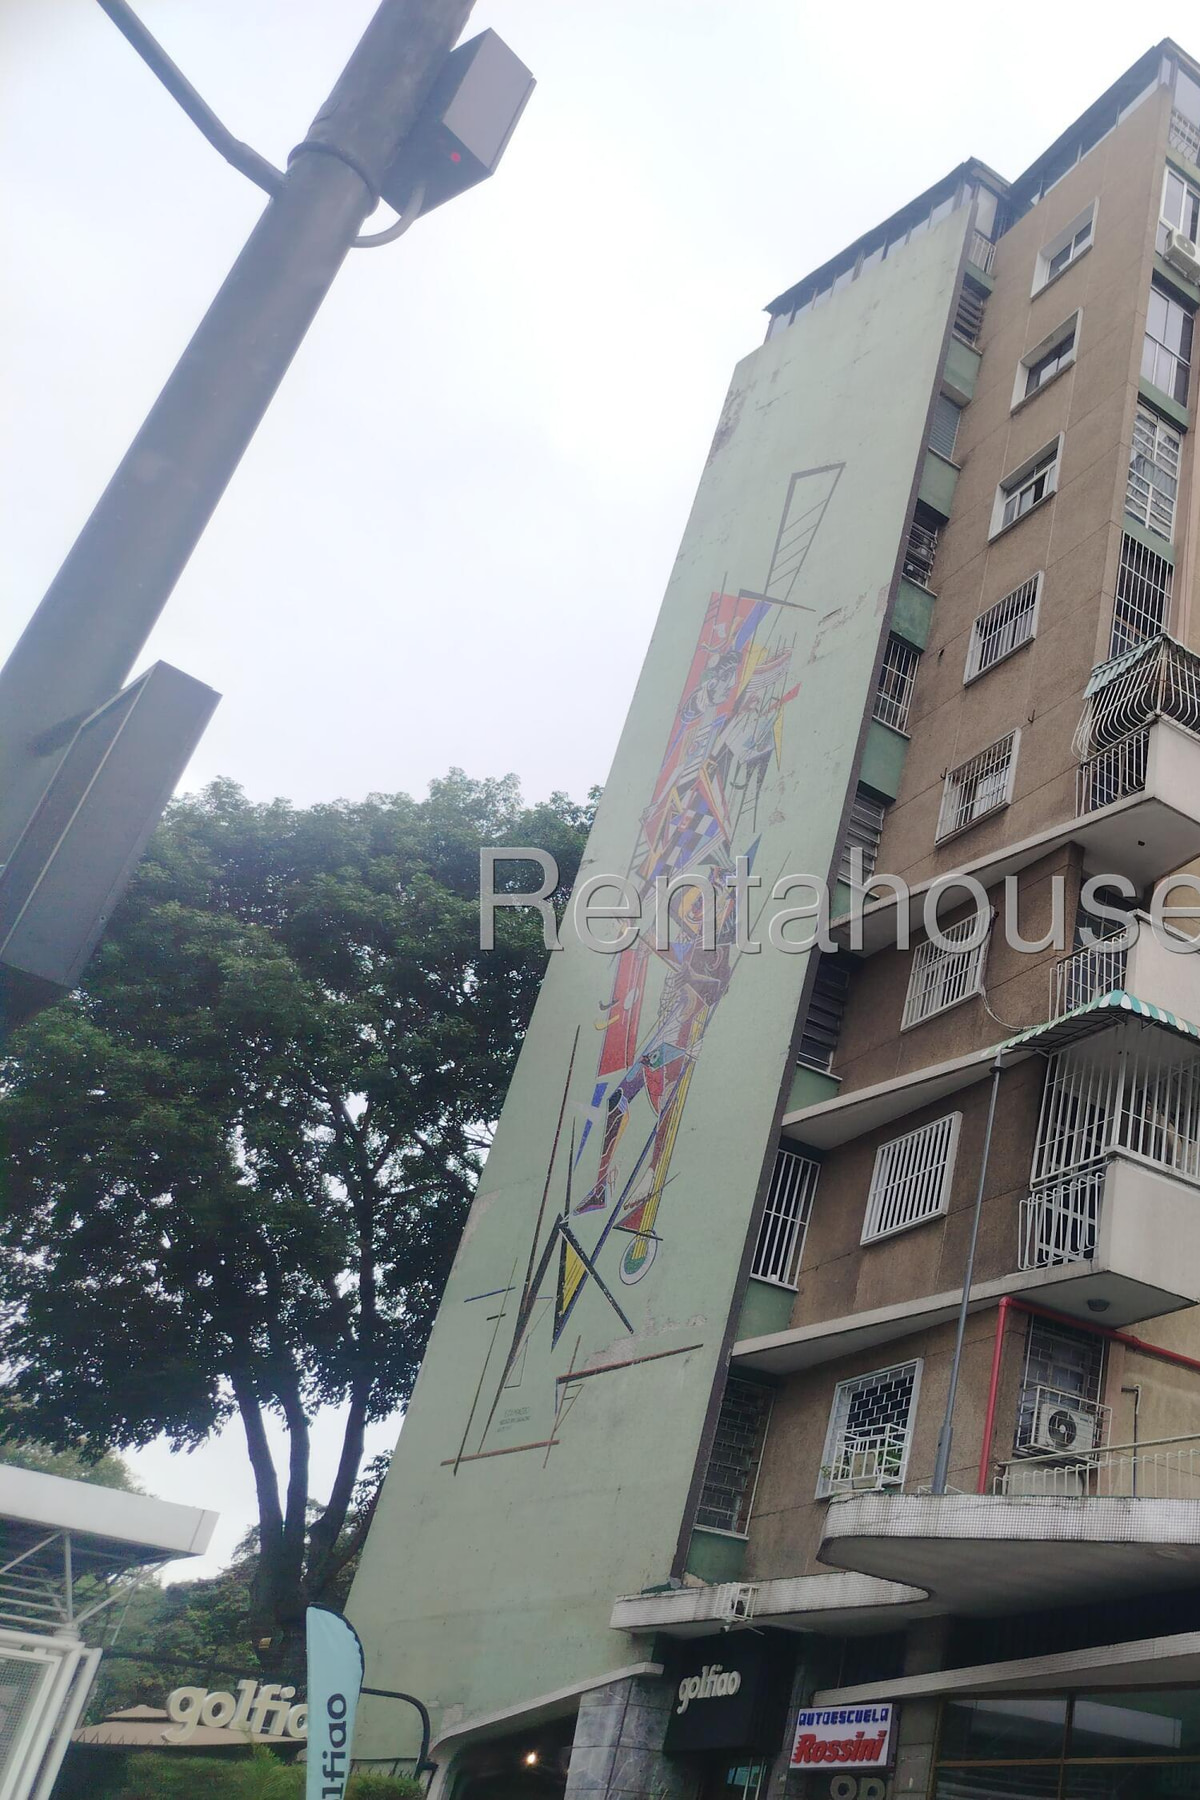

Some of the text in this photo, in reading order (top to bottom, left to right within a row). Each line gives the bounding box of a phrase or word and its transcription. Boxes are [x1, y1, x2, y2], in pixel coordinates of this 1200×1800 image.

[161, 1679, 308, 1743] golfia
[676, 1664, 741, 1714] golfiao
[799, 1707, 889, 1726] AUTOESCUELA
[322, 1693, 347, 1800] lfiao
[792, 1730, 887, 1763] Rossini
